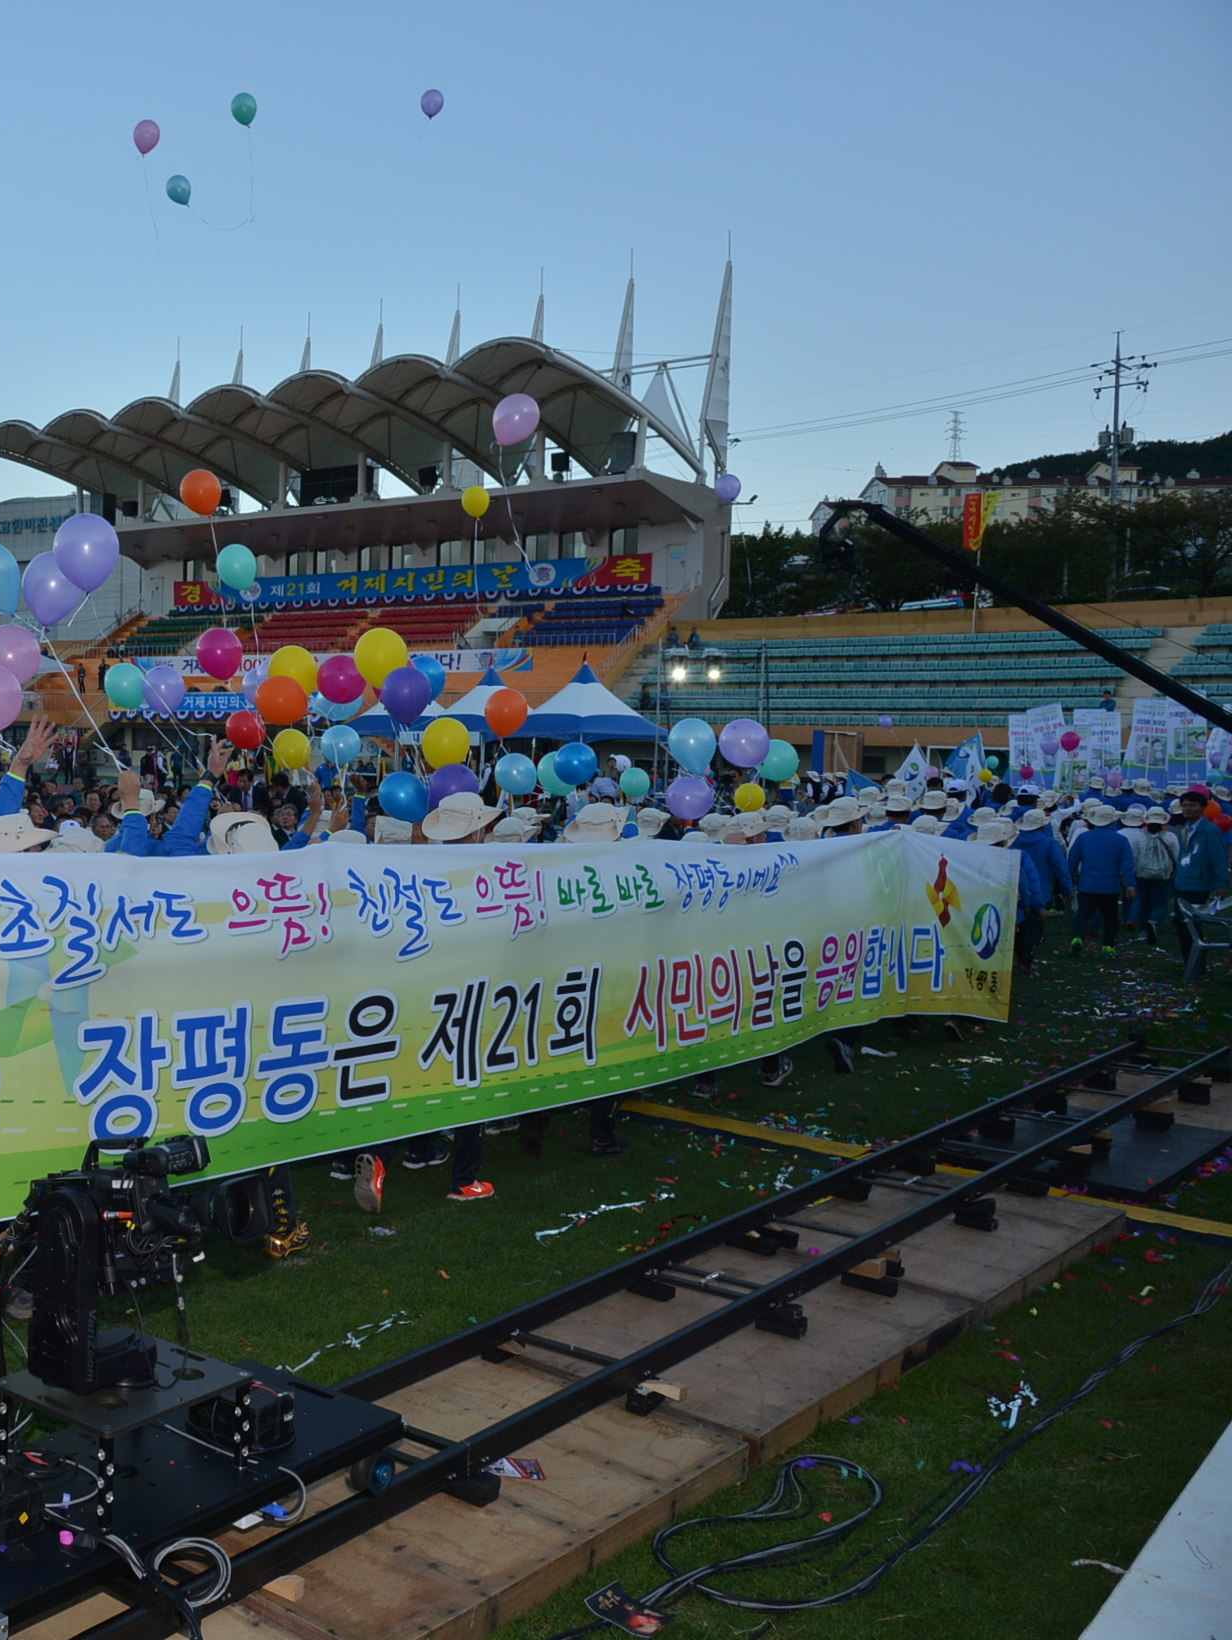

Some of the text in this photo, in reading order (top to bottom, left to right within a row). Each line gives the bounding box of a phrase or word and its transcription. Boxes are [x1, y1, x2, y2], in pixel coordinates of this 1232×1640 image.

[181, 558, 645, 602] 경 제21회 거제시민의 날 축
[184, 695, 240, 709] 거제시민의
[228, 872, 329, 954] 으뜸!
[347, 867, 464, 959] 친절도
[476, 860, 544, 935] 으뜸!
[78, 994, 398, 1140] 장평동은
[419, 967, 600, 1082] 제21회
